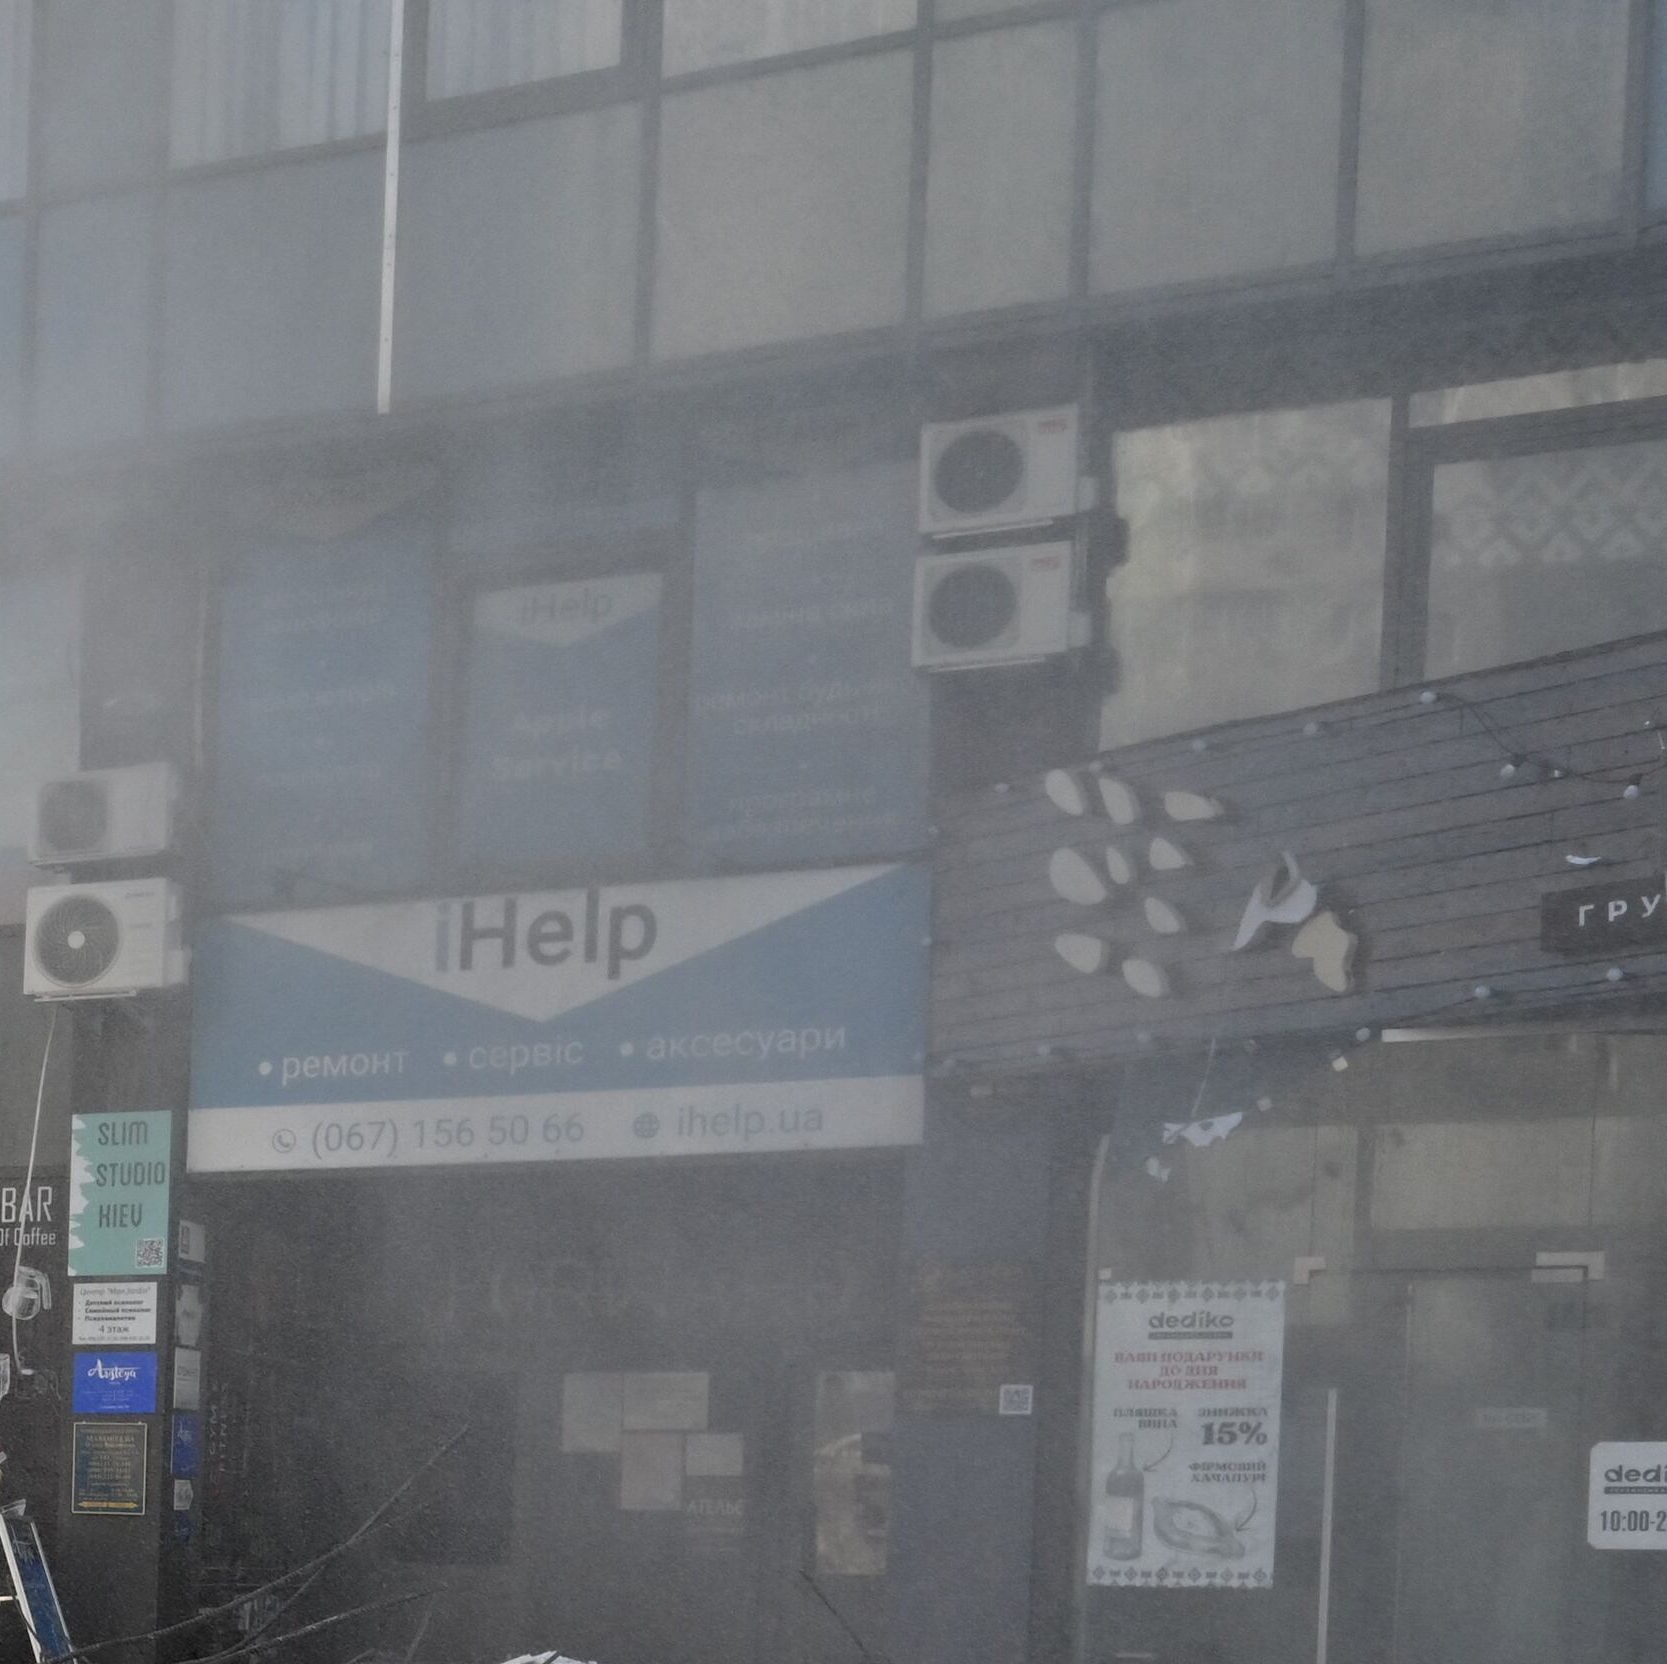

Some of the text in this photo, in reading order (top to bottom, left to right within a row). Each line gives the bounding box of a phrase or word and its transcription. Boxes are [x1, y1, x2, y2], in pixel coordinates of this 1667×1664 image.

[433, 884, 659, 981] iHelp
[281, 1024, 847, 1086] ремонт сервіс аксесуари
[97, 1120, 148, 1147] SLIM
[311, 1101, 824, 1160] (067) 156 50 66 ihelp.ua
[95, 1161, 166, 1189] STUDIO
[1, 1186, 53, 1224] BAR
[98, 1202, 143, 1229] KIEV
[14, 1227, 56, 1247] Coffee
[1148, 1311, 1235, 1330] dediko
[1201, 1420, 1268, 1446] 15%
